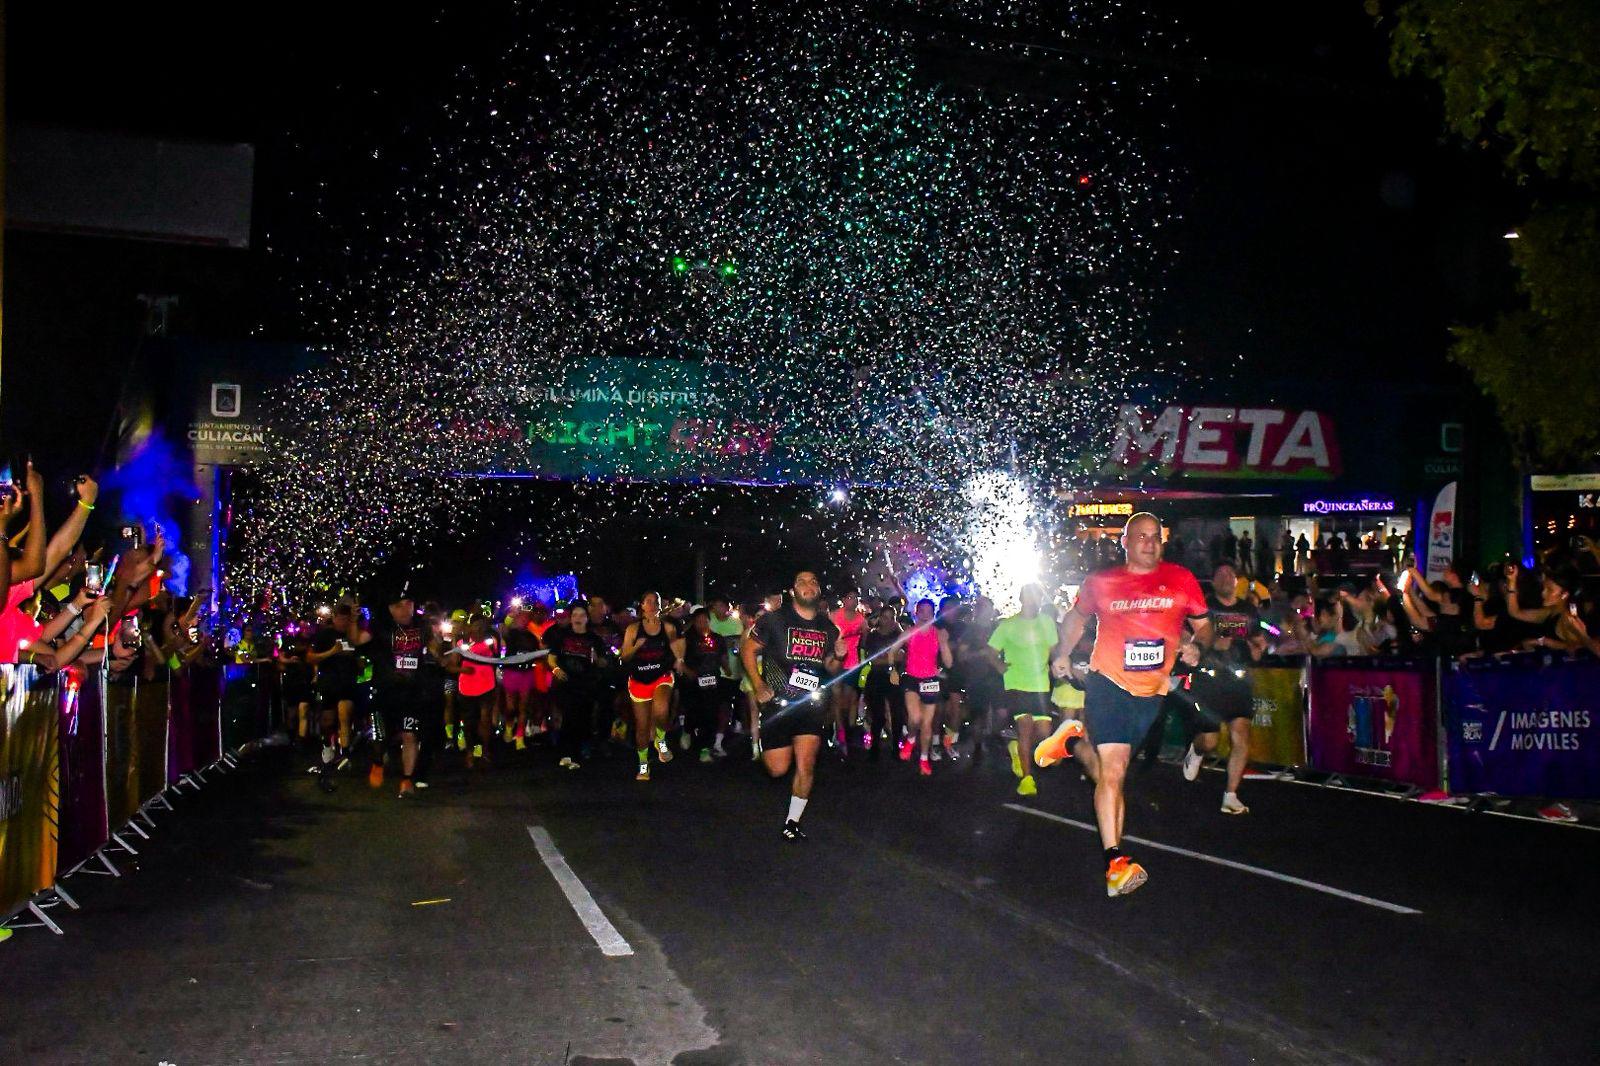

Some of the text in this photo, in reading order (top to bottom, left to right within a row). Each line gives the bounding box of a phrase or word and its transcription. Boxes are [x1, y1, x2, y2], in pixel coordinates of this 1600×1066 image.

[1107, 403, 1331, 467] META
[792, 637, 826, 648] NIGHT
[791, 644, 825, 658] RUN
[1130, 651, 1161, 662] 01861
[795, 676, 818, 688] 03276
